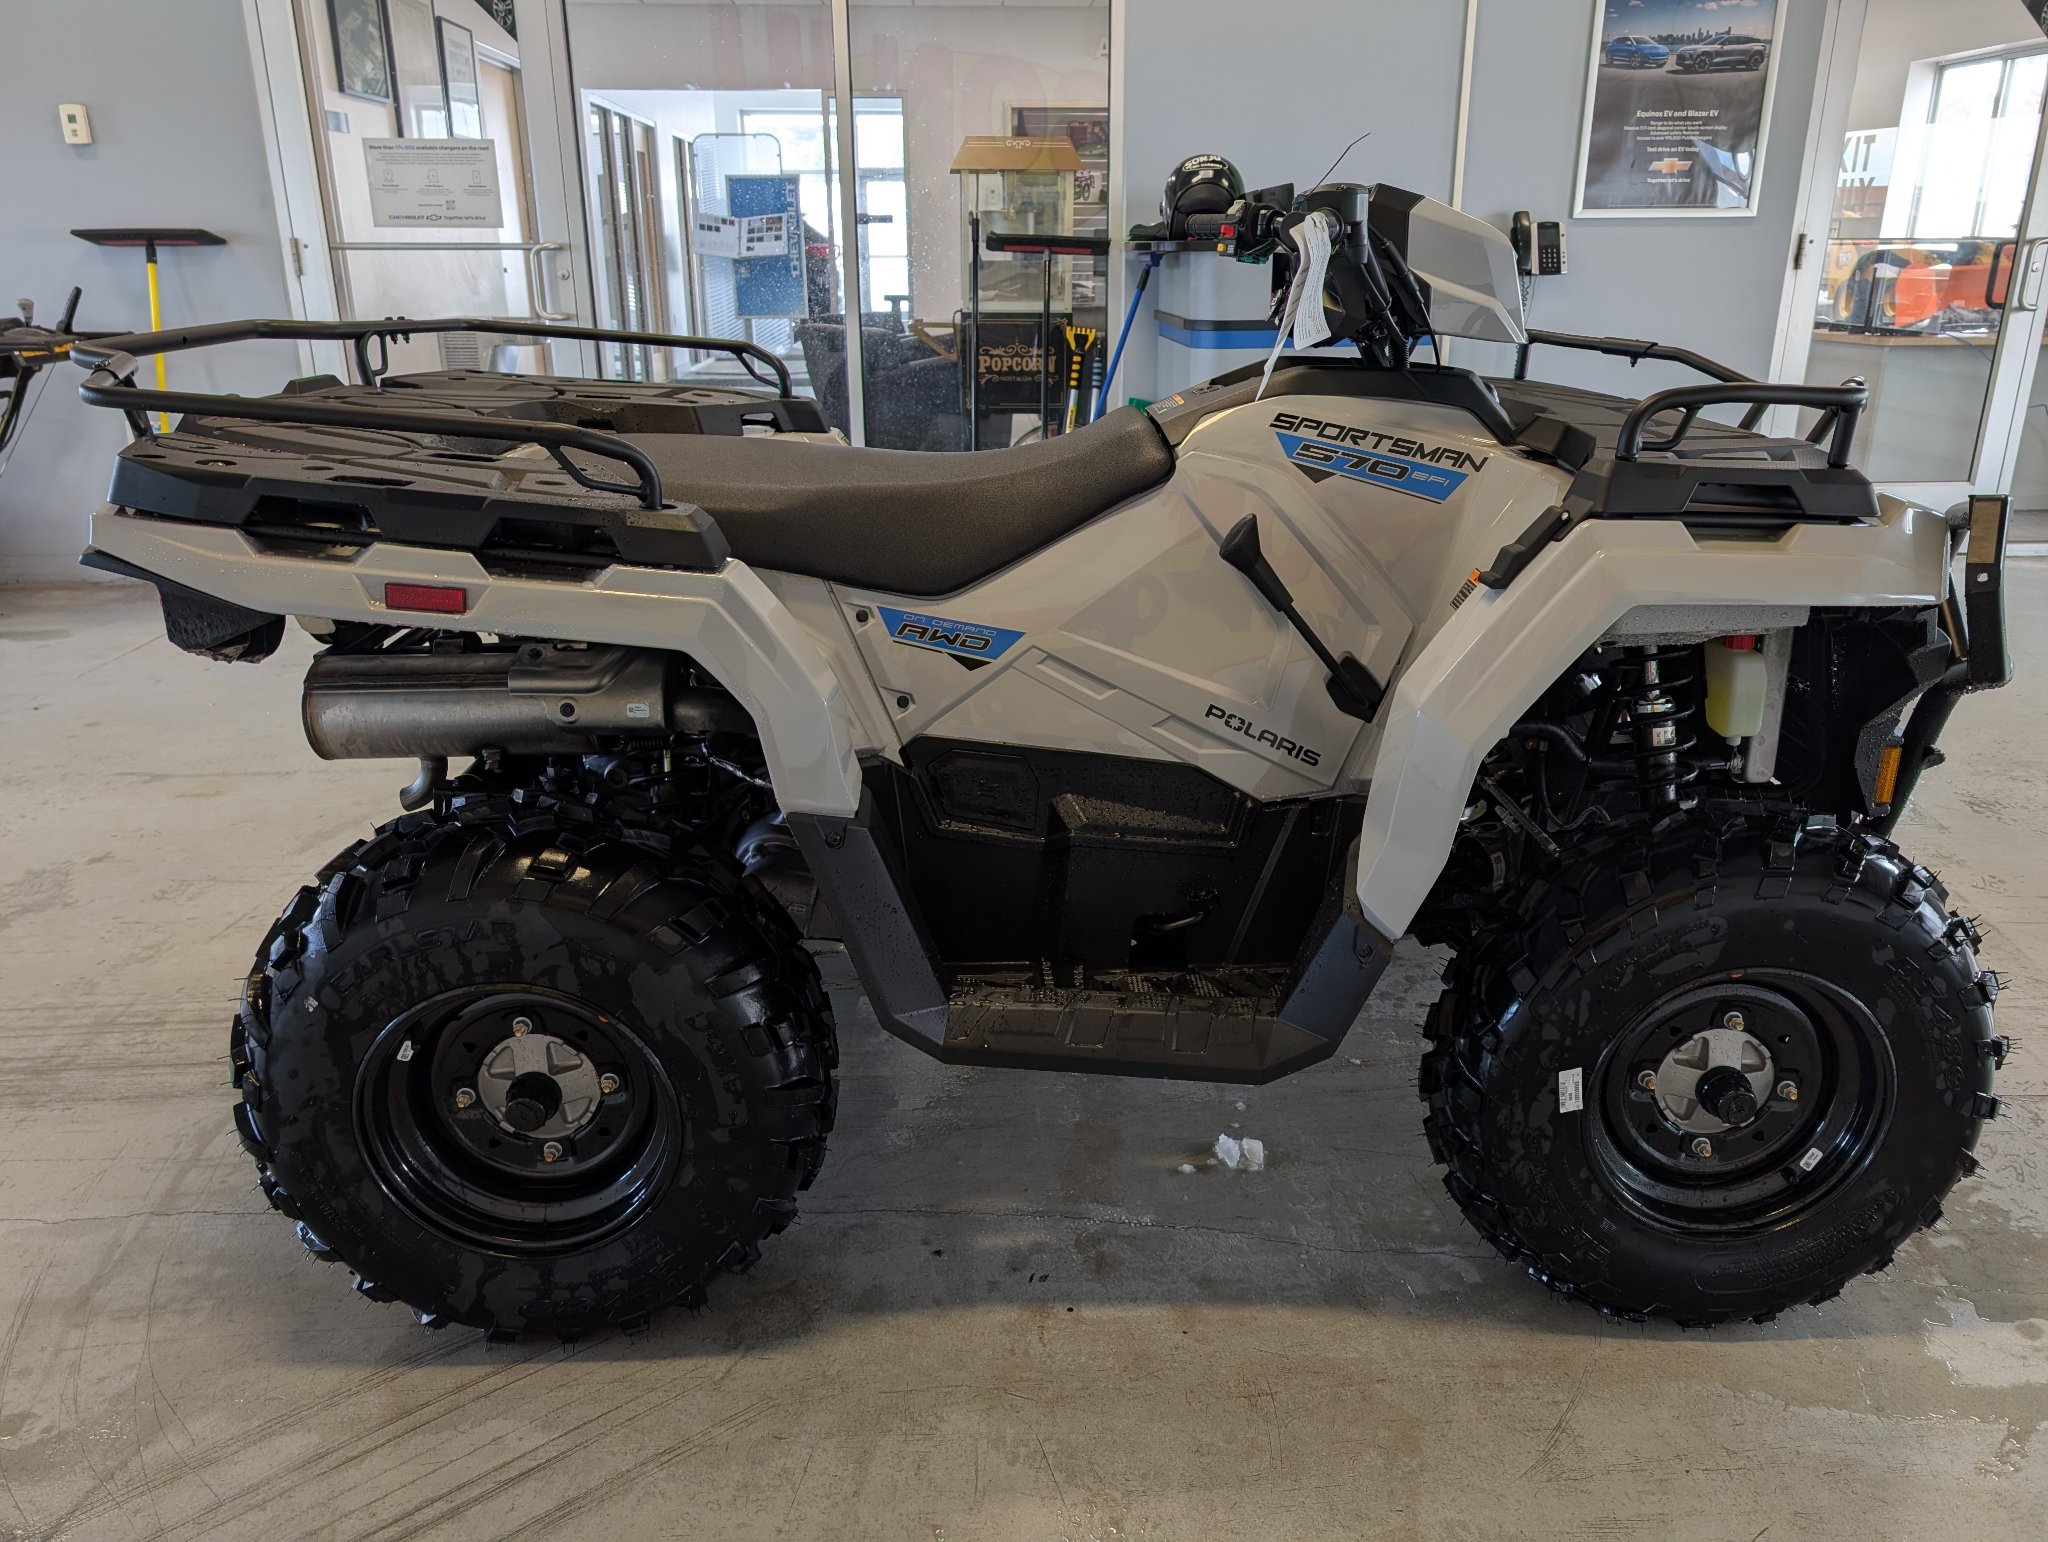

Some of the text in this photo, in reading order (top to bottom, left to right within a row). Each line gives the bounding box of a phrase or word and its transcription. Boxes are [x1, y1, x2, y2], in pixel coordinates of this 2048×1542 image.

[1636, 110, 1662, 118] Equinox
[1184, 155, 1222, 167] SONJU
[786, 182, 800, 275] CHEVROLET
[1269, 412, 1489, 473] SPORTSMAN
[1293, 442, 1450, 487] 570 EFI
[895, 622, 992, 651] AWD
[903, 613, 996, 636] ON DEMAND
[1204, 703, 1322, 767] POLARIS
